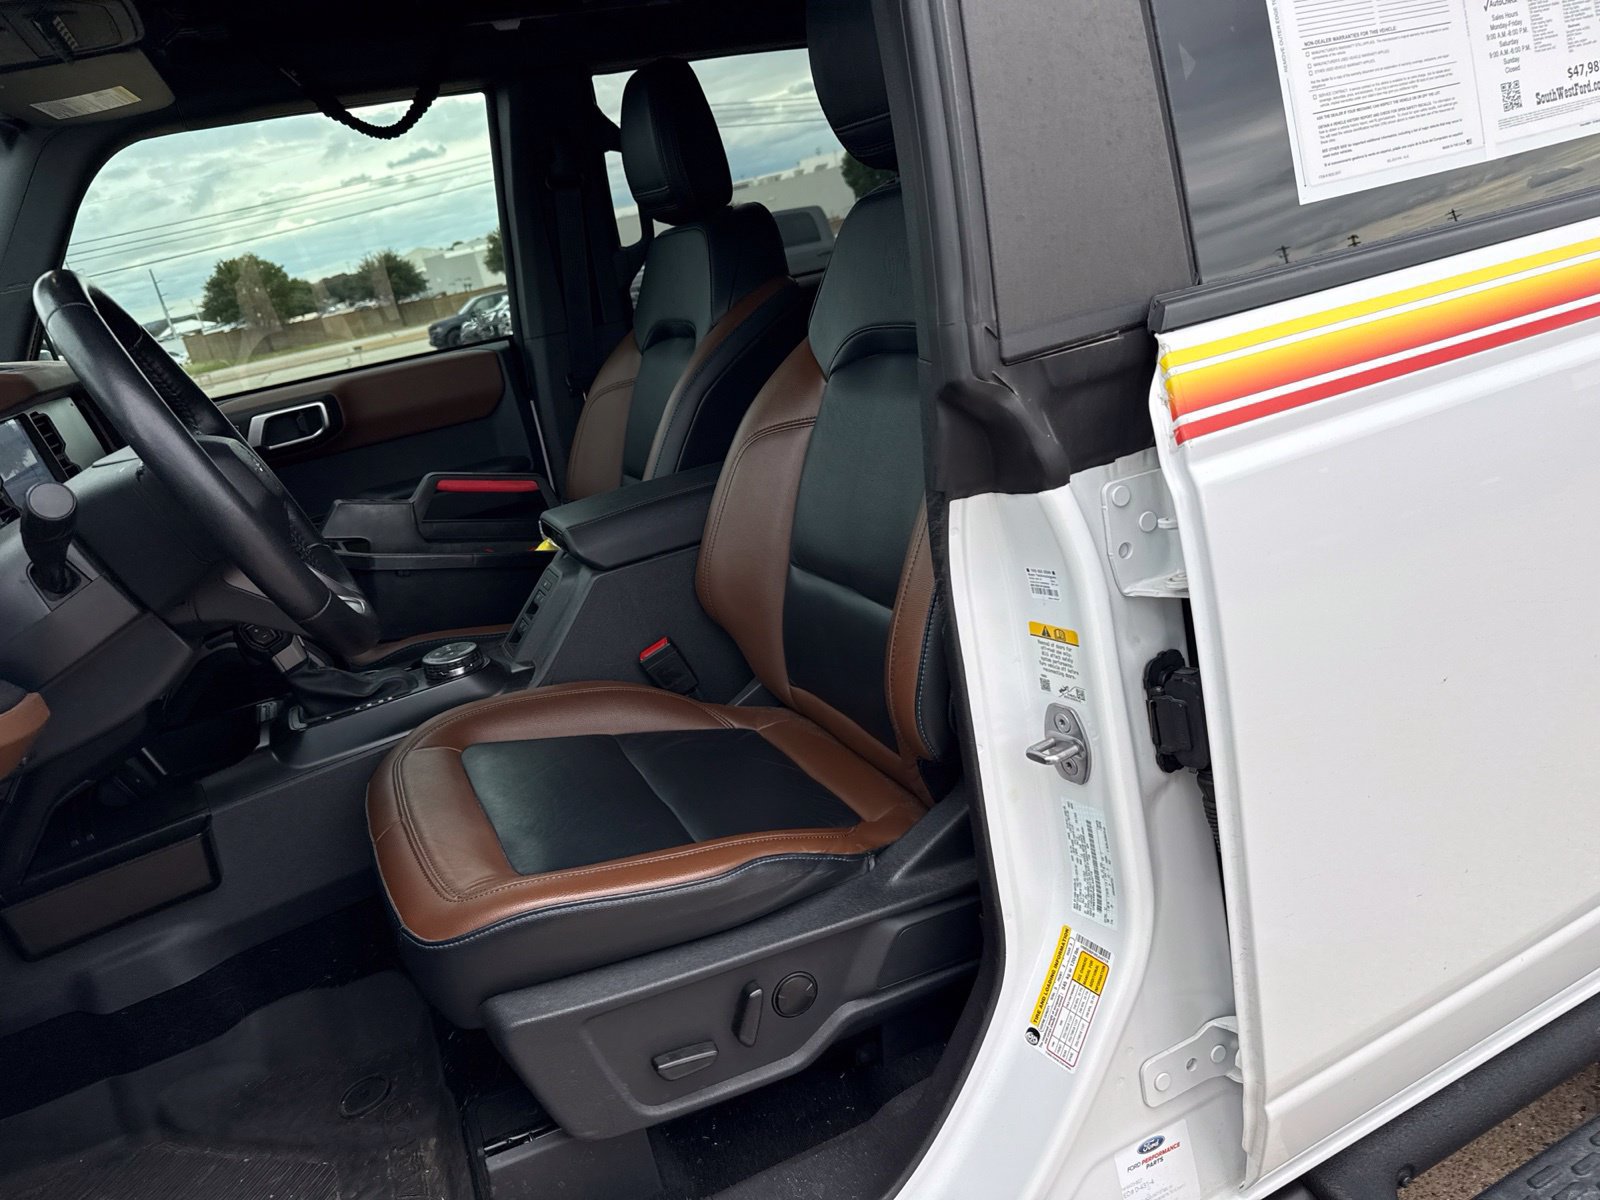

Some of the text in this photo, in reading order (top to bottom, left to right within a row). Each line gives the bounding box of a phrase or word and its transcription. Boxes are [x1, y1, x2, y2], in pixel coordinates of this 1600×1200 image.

[1499, 39, 1519, 48] Saturday
[1503, 57, 1520, 65] Sunday
[1505, 65, 1521, 74] Closed
[1567, 60, 1600, 80] $47,98
[1033, 928, 1070, 1023] TIRE AND LOADING INFORMATION
[1082, 969, 1090, 985] MANUAL
[1094, 965, 1106, 991] INFORMATION
[1142, 1139, 1160, 1152] Ford
[1127, 1142, 1180, 1173] FORD PERFORMANCE
[1146, 1156, 1164, 1169] PARTS
